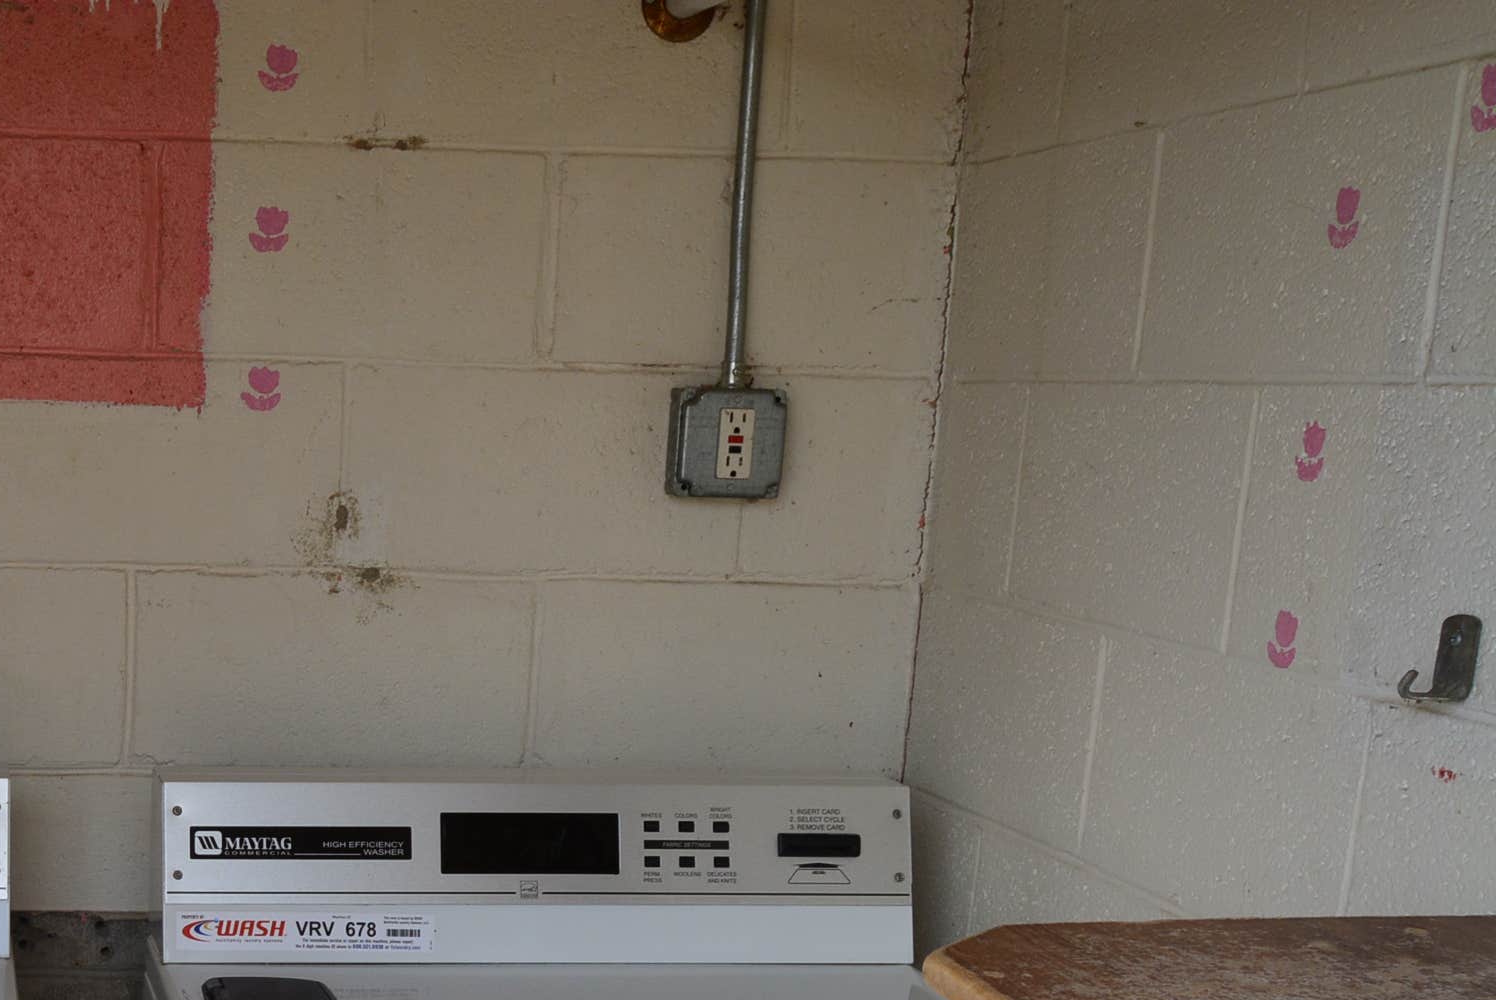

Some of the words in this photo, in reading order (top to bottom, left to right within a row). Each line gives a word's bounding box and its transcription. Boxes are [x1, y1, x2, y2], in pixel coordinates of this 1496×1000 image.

[821, 808, 841, 816] CARD
[823, 816, 845, 824] CYCLE
[796, 823, 825, 831] REMOVE
[826, 823, 846, 831] CARD
[224, 836, 292, 850] MAYTAG
[322, 840, 347, 848] HIGH
[348, 840, 405, 849] EFFICIENCY
[363, 848, 405, 856] WASHER
[215, 919, 286, 937] WASH
[295, 920, 335, 937] VRV
[345, 921, 377, 938] 678
